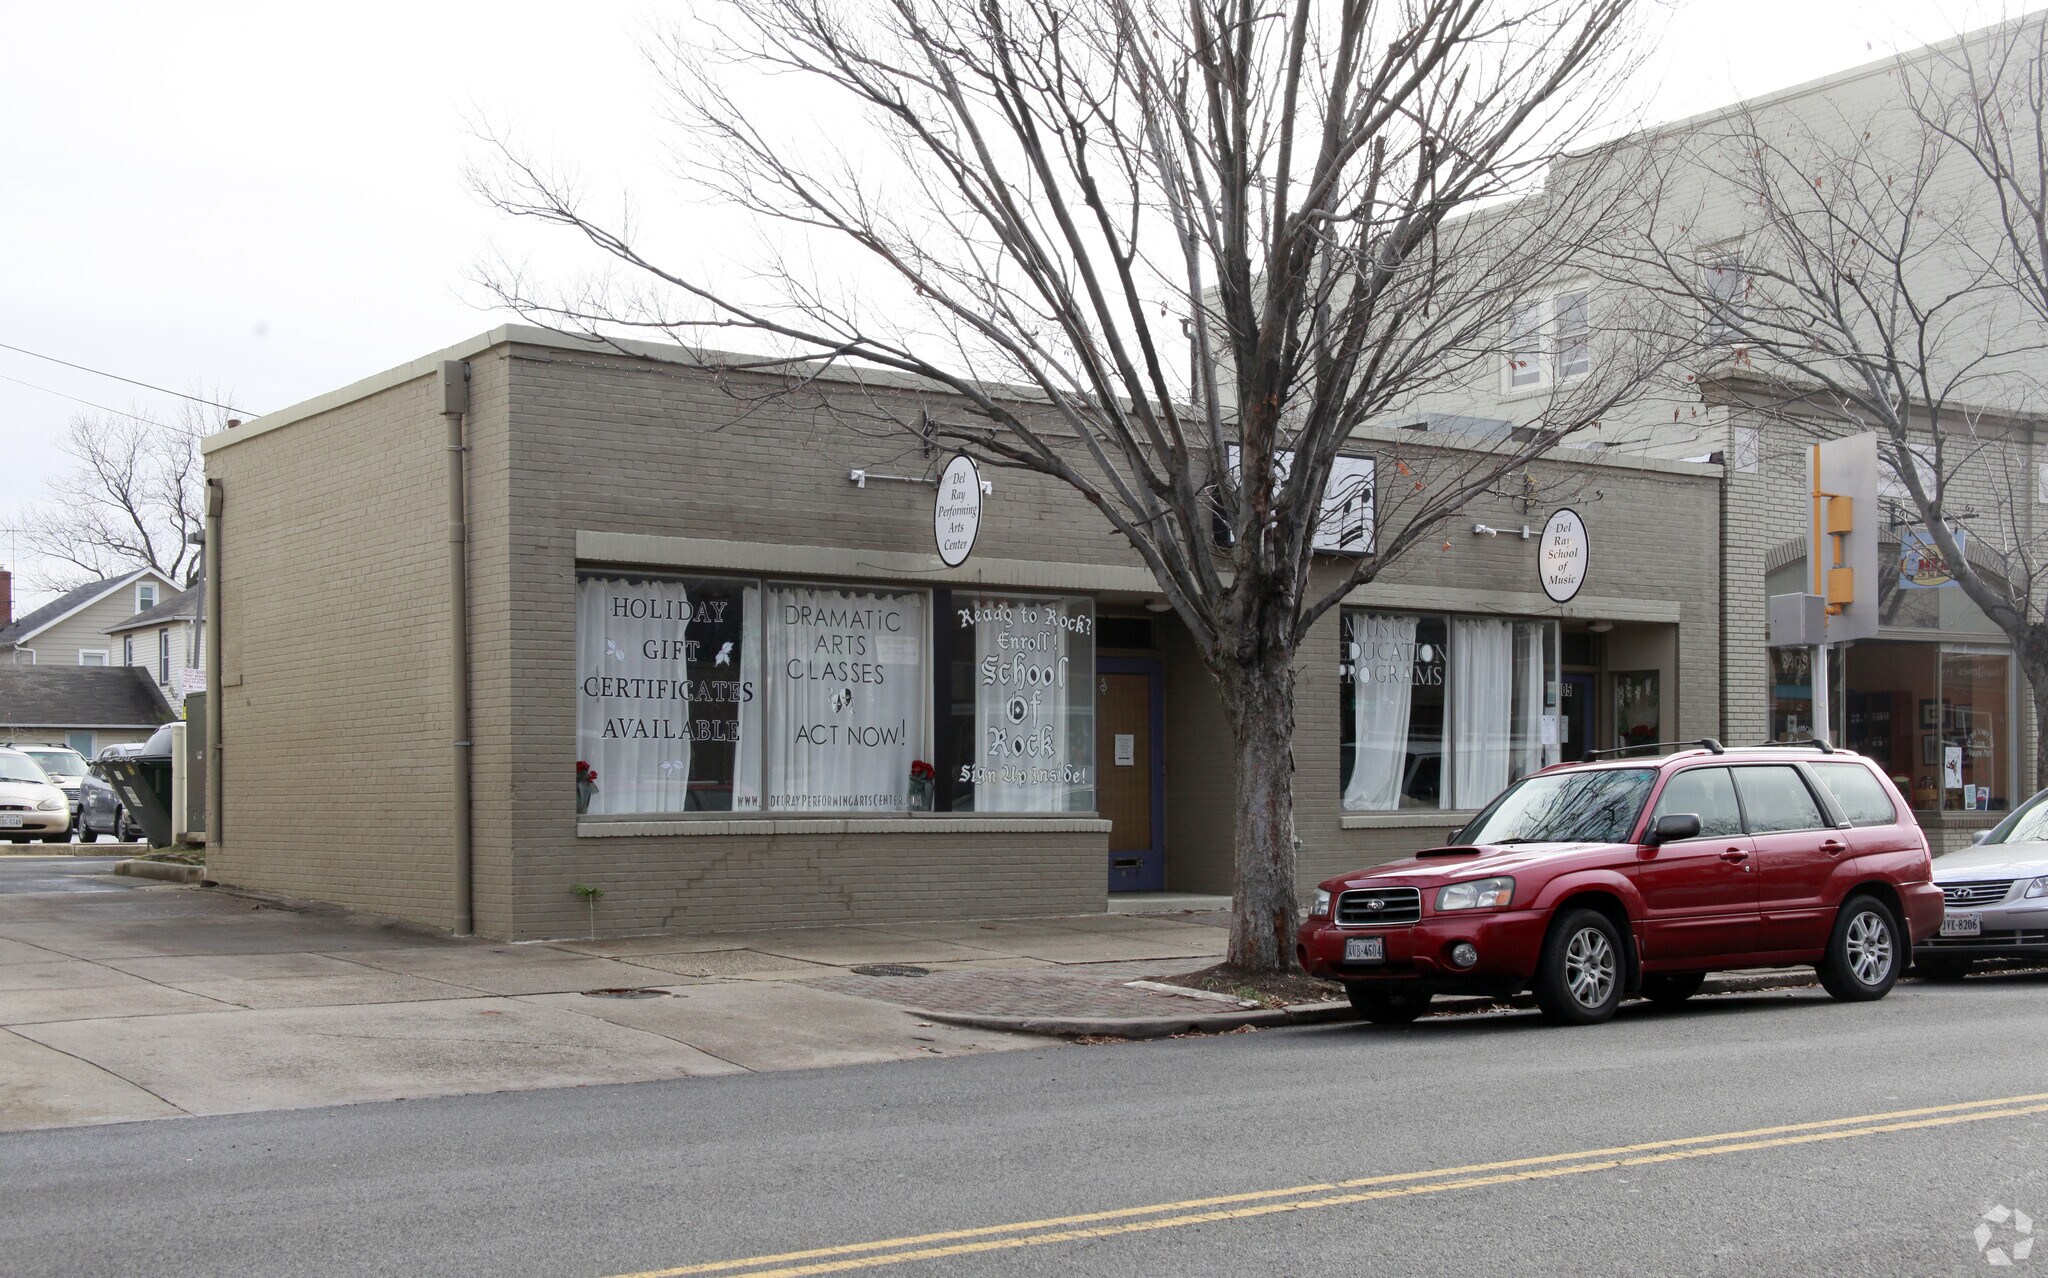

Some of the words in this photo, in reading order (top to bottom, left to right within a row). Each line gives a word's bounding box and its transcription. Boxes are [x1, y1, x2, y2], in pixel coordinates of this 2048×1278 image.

[953, 471, 966, 484] Del
[951, 488, 966, 503] Ray
[938, 504, 977, 520] Performing
[948, 522, 964, 534] Arts
[1555, 522, 1571, 533] Del
[944, 538, 968, 551] Center
[1548, 548, 1578, 559] School
[1548, 574, 1577, 585] Music
[1558, 561, 1568, 575] of
[612, 597, 728, 624] HOLIDAY
[958, 604, 1014, 628] Ready
[1020, 607, 1038, 624] to
[1045, 607, 1092, 636] Rock?
[1344, 616, 1412, 640] MUSIC
[642, 639, 700, 662] GIFT
[814, 635, 866, 656] ARTS
[786, 659, 884, 685] CLASSES
[981, 652, 1069, 690] School
[1340, 664, 1442, 686] PROGRAMS
[583, 677, 754, 702] CERTIFICATES
[1006, 689, 1042, 728] Of
[601, 718, 740, 741] AVAILABLE
[795, 724, 838, 745] ACT
[847, 718, 906, 748] NOW!
[988, 725, 1055, 758] Rock
[958, 764, 997, 785] Sign
[1002, 764, 1027, 788] Up
[1032, 763, 1087, 785] Inside!
